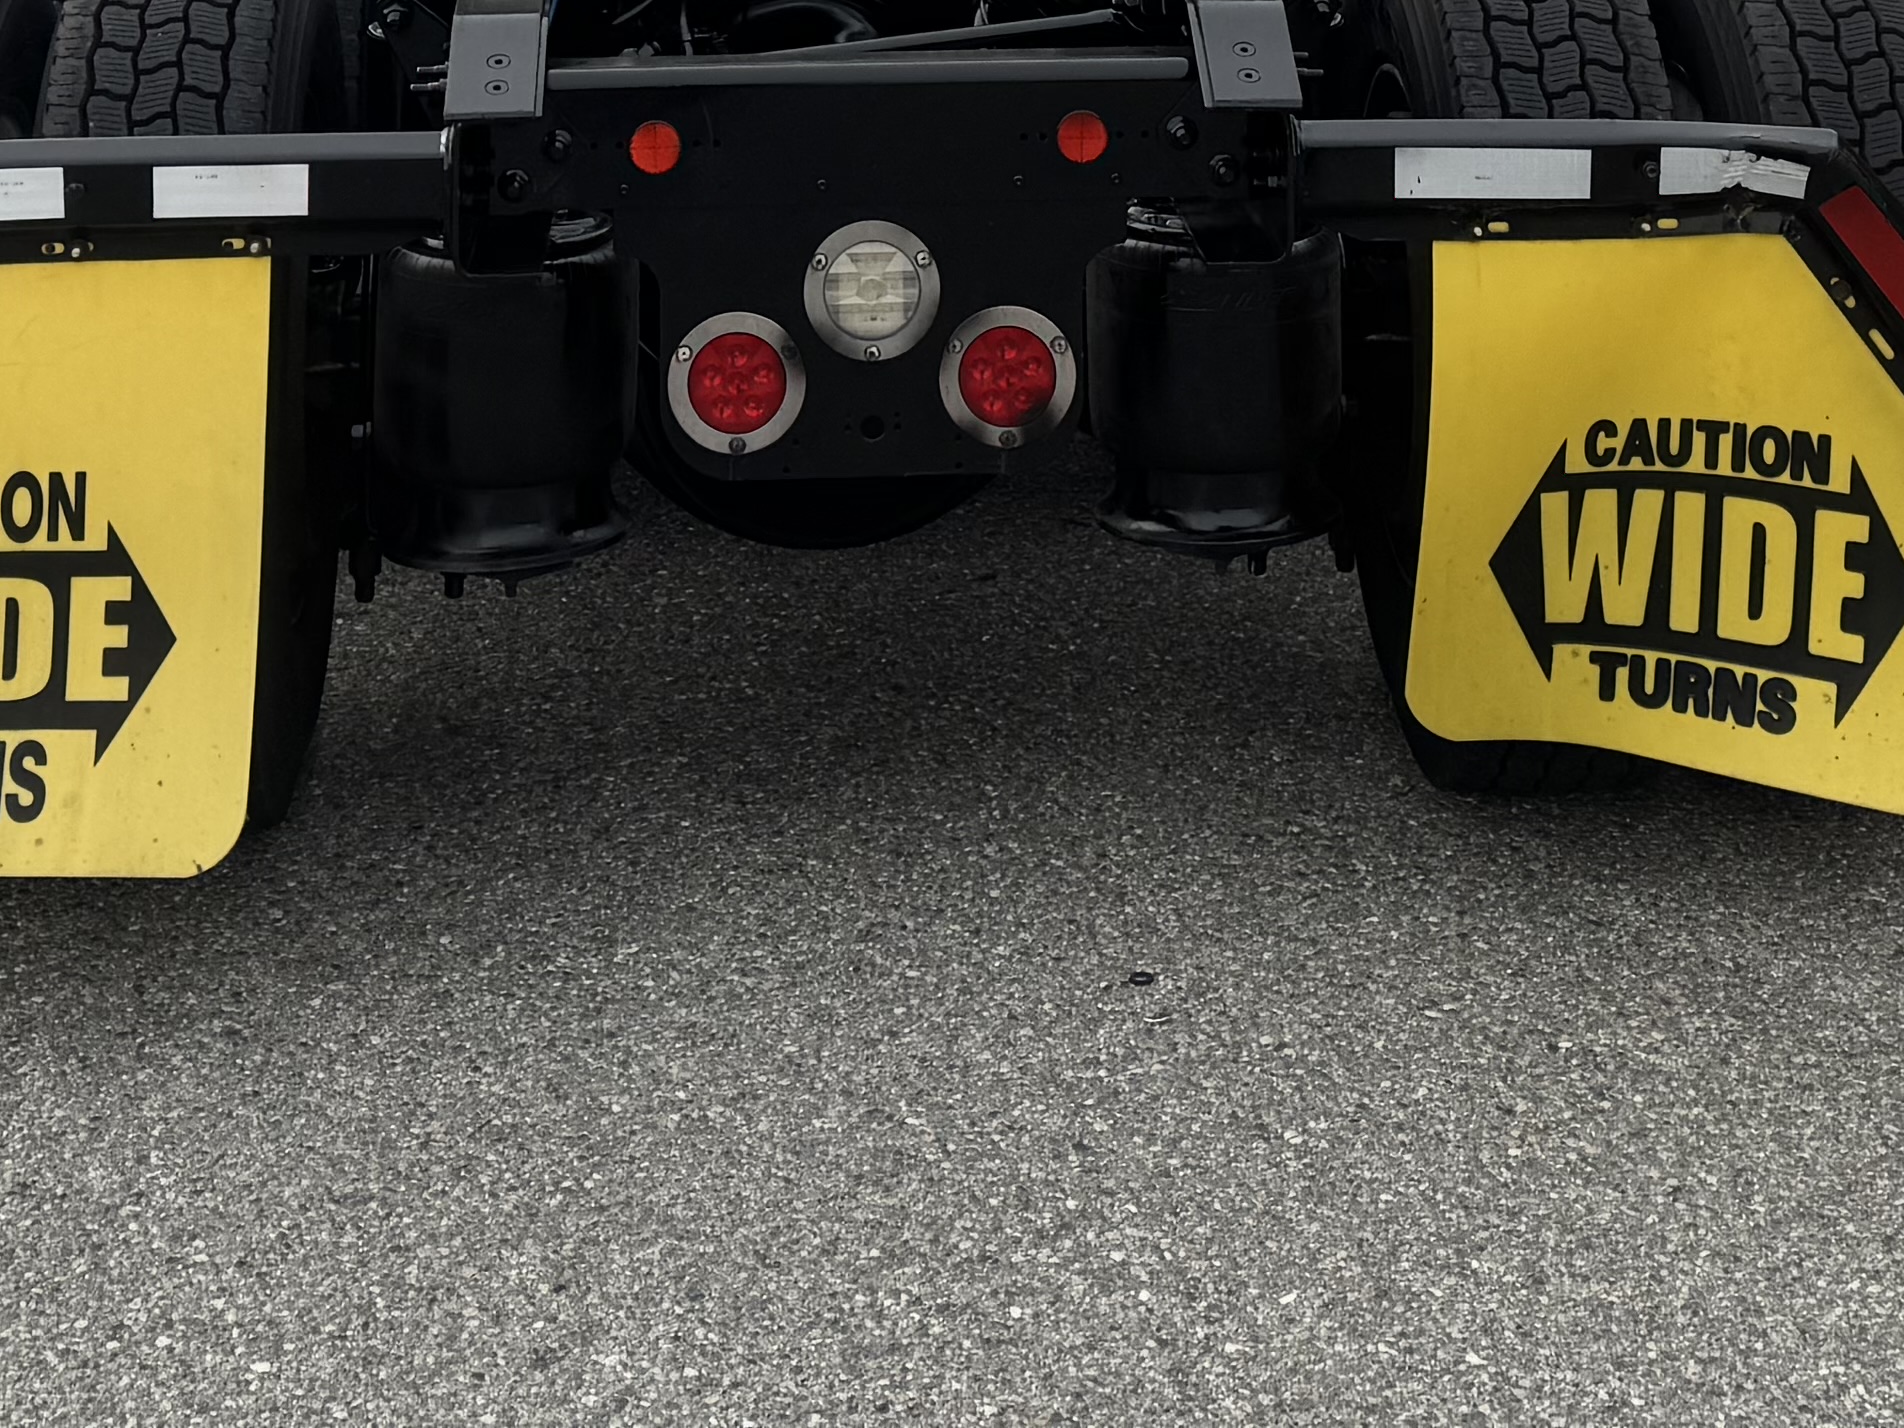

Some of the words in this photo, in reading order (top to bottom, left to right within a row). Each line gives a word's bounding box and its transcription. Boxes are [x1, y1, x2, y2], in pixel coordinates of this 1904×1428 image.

[1583, 417, 1832, 486] CAUTION
[1540, 488, 1871, 664] WIDE
[1589, 650, 1798, 736] TURNS
